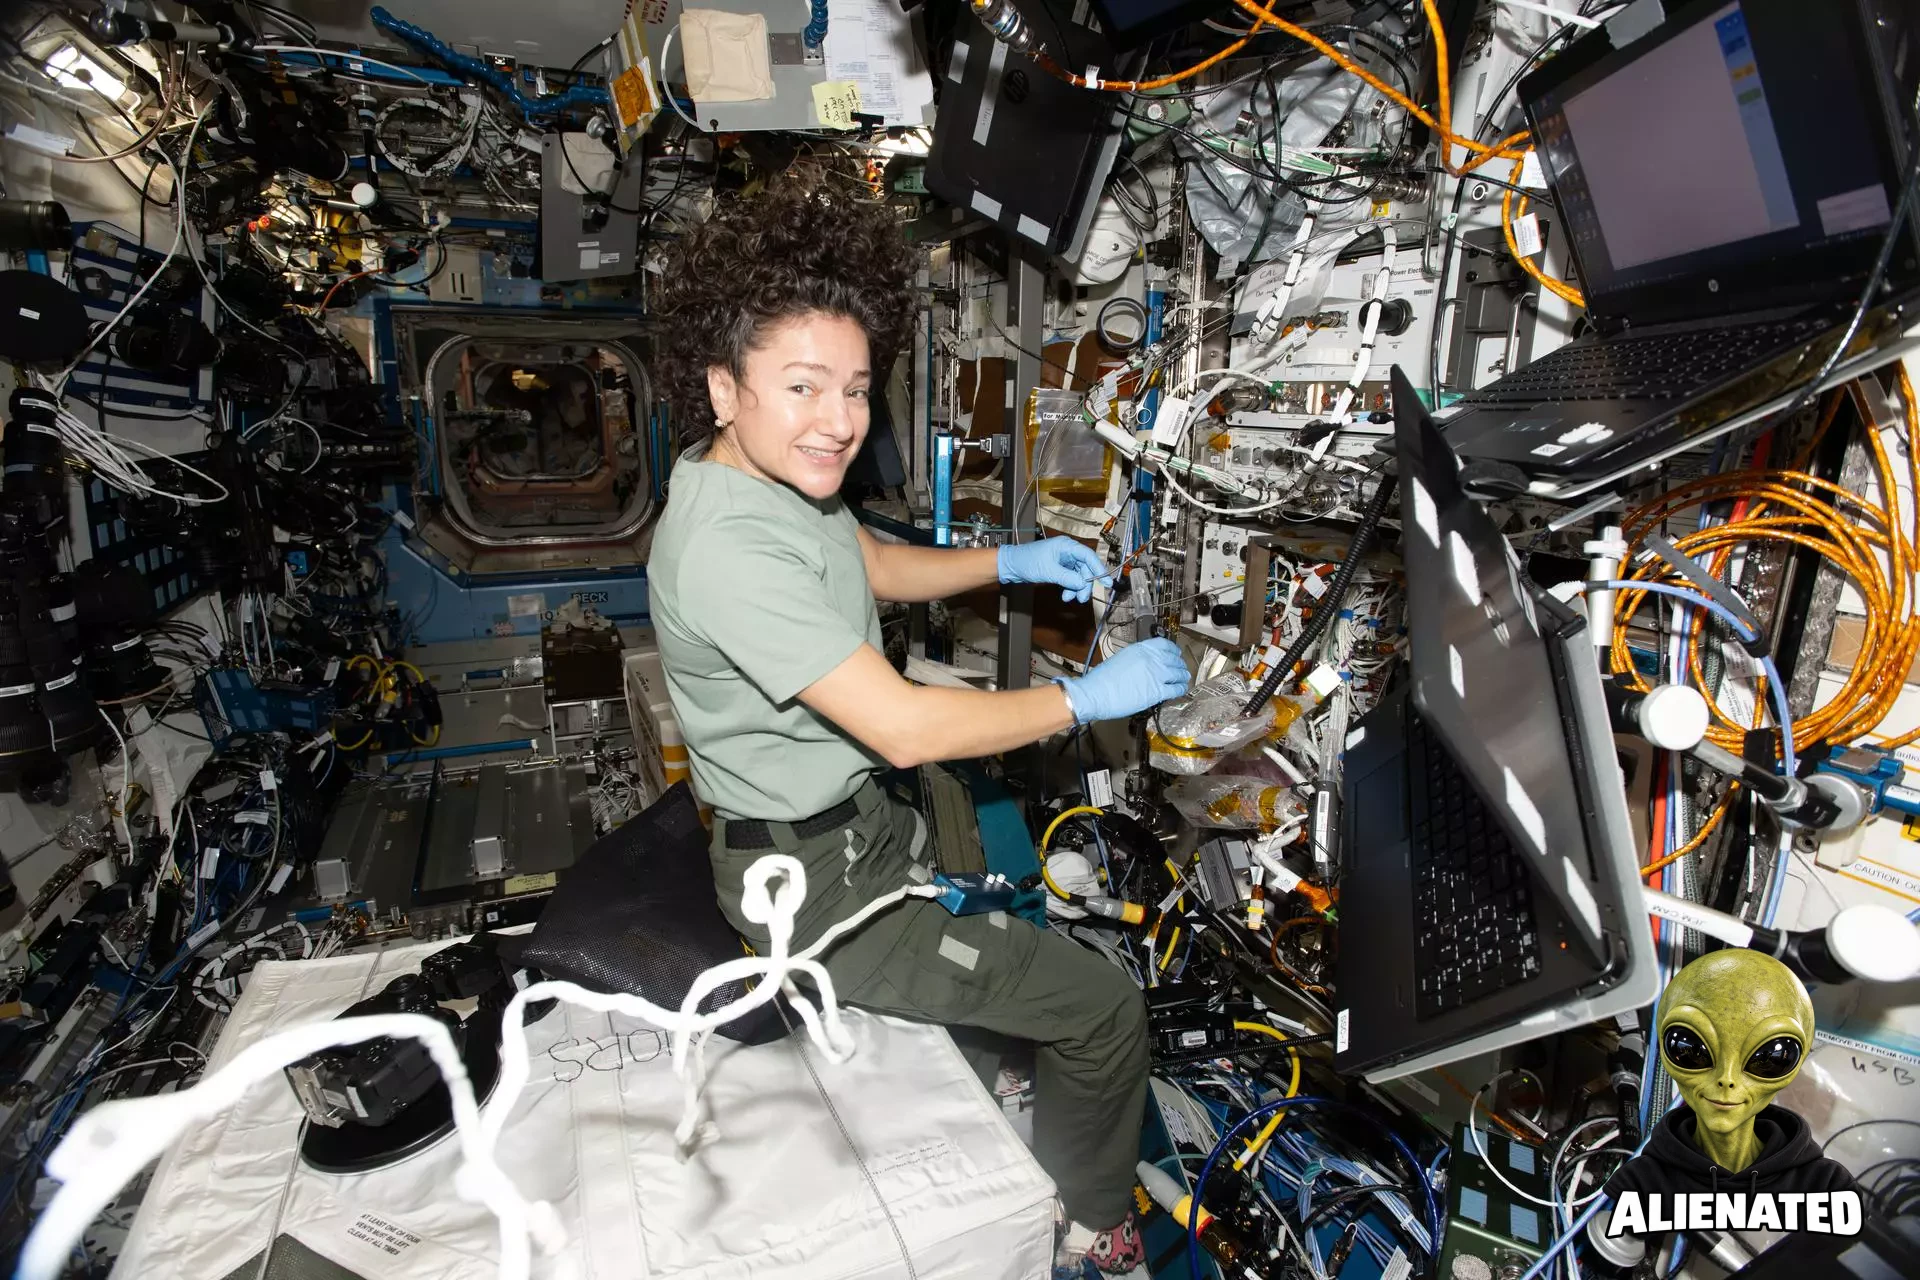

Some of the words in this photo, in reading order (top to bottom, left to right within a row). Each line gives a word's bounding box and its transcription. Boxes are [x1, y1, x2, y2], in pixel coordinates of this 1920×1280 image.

[1854, 863, 1900, 885] CAUTION
[1817, 1031, 1853, 1046] REMOVE
[1854, 1041, 1869, 1050] KIT
[1870, 1046, 1897, 1058] FROM
[347, 1227, 367, 1240] CLEAR
[371, 1240, 384, 1248] ALL
[382, 1244, 401, 1256] TIMES
[355, 1221, 374, 1232] VENTS
[372, 1229, 389, 1239] MUST
[385, 1235, 396, 1243] BE
[394, 1239, 410, 1249] LEFT
[368, 1217, 387, 1228] LEAST
[384, 1224, 398, 1233] ONE
[403, 1233, 421, 1244] FOUR
